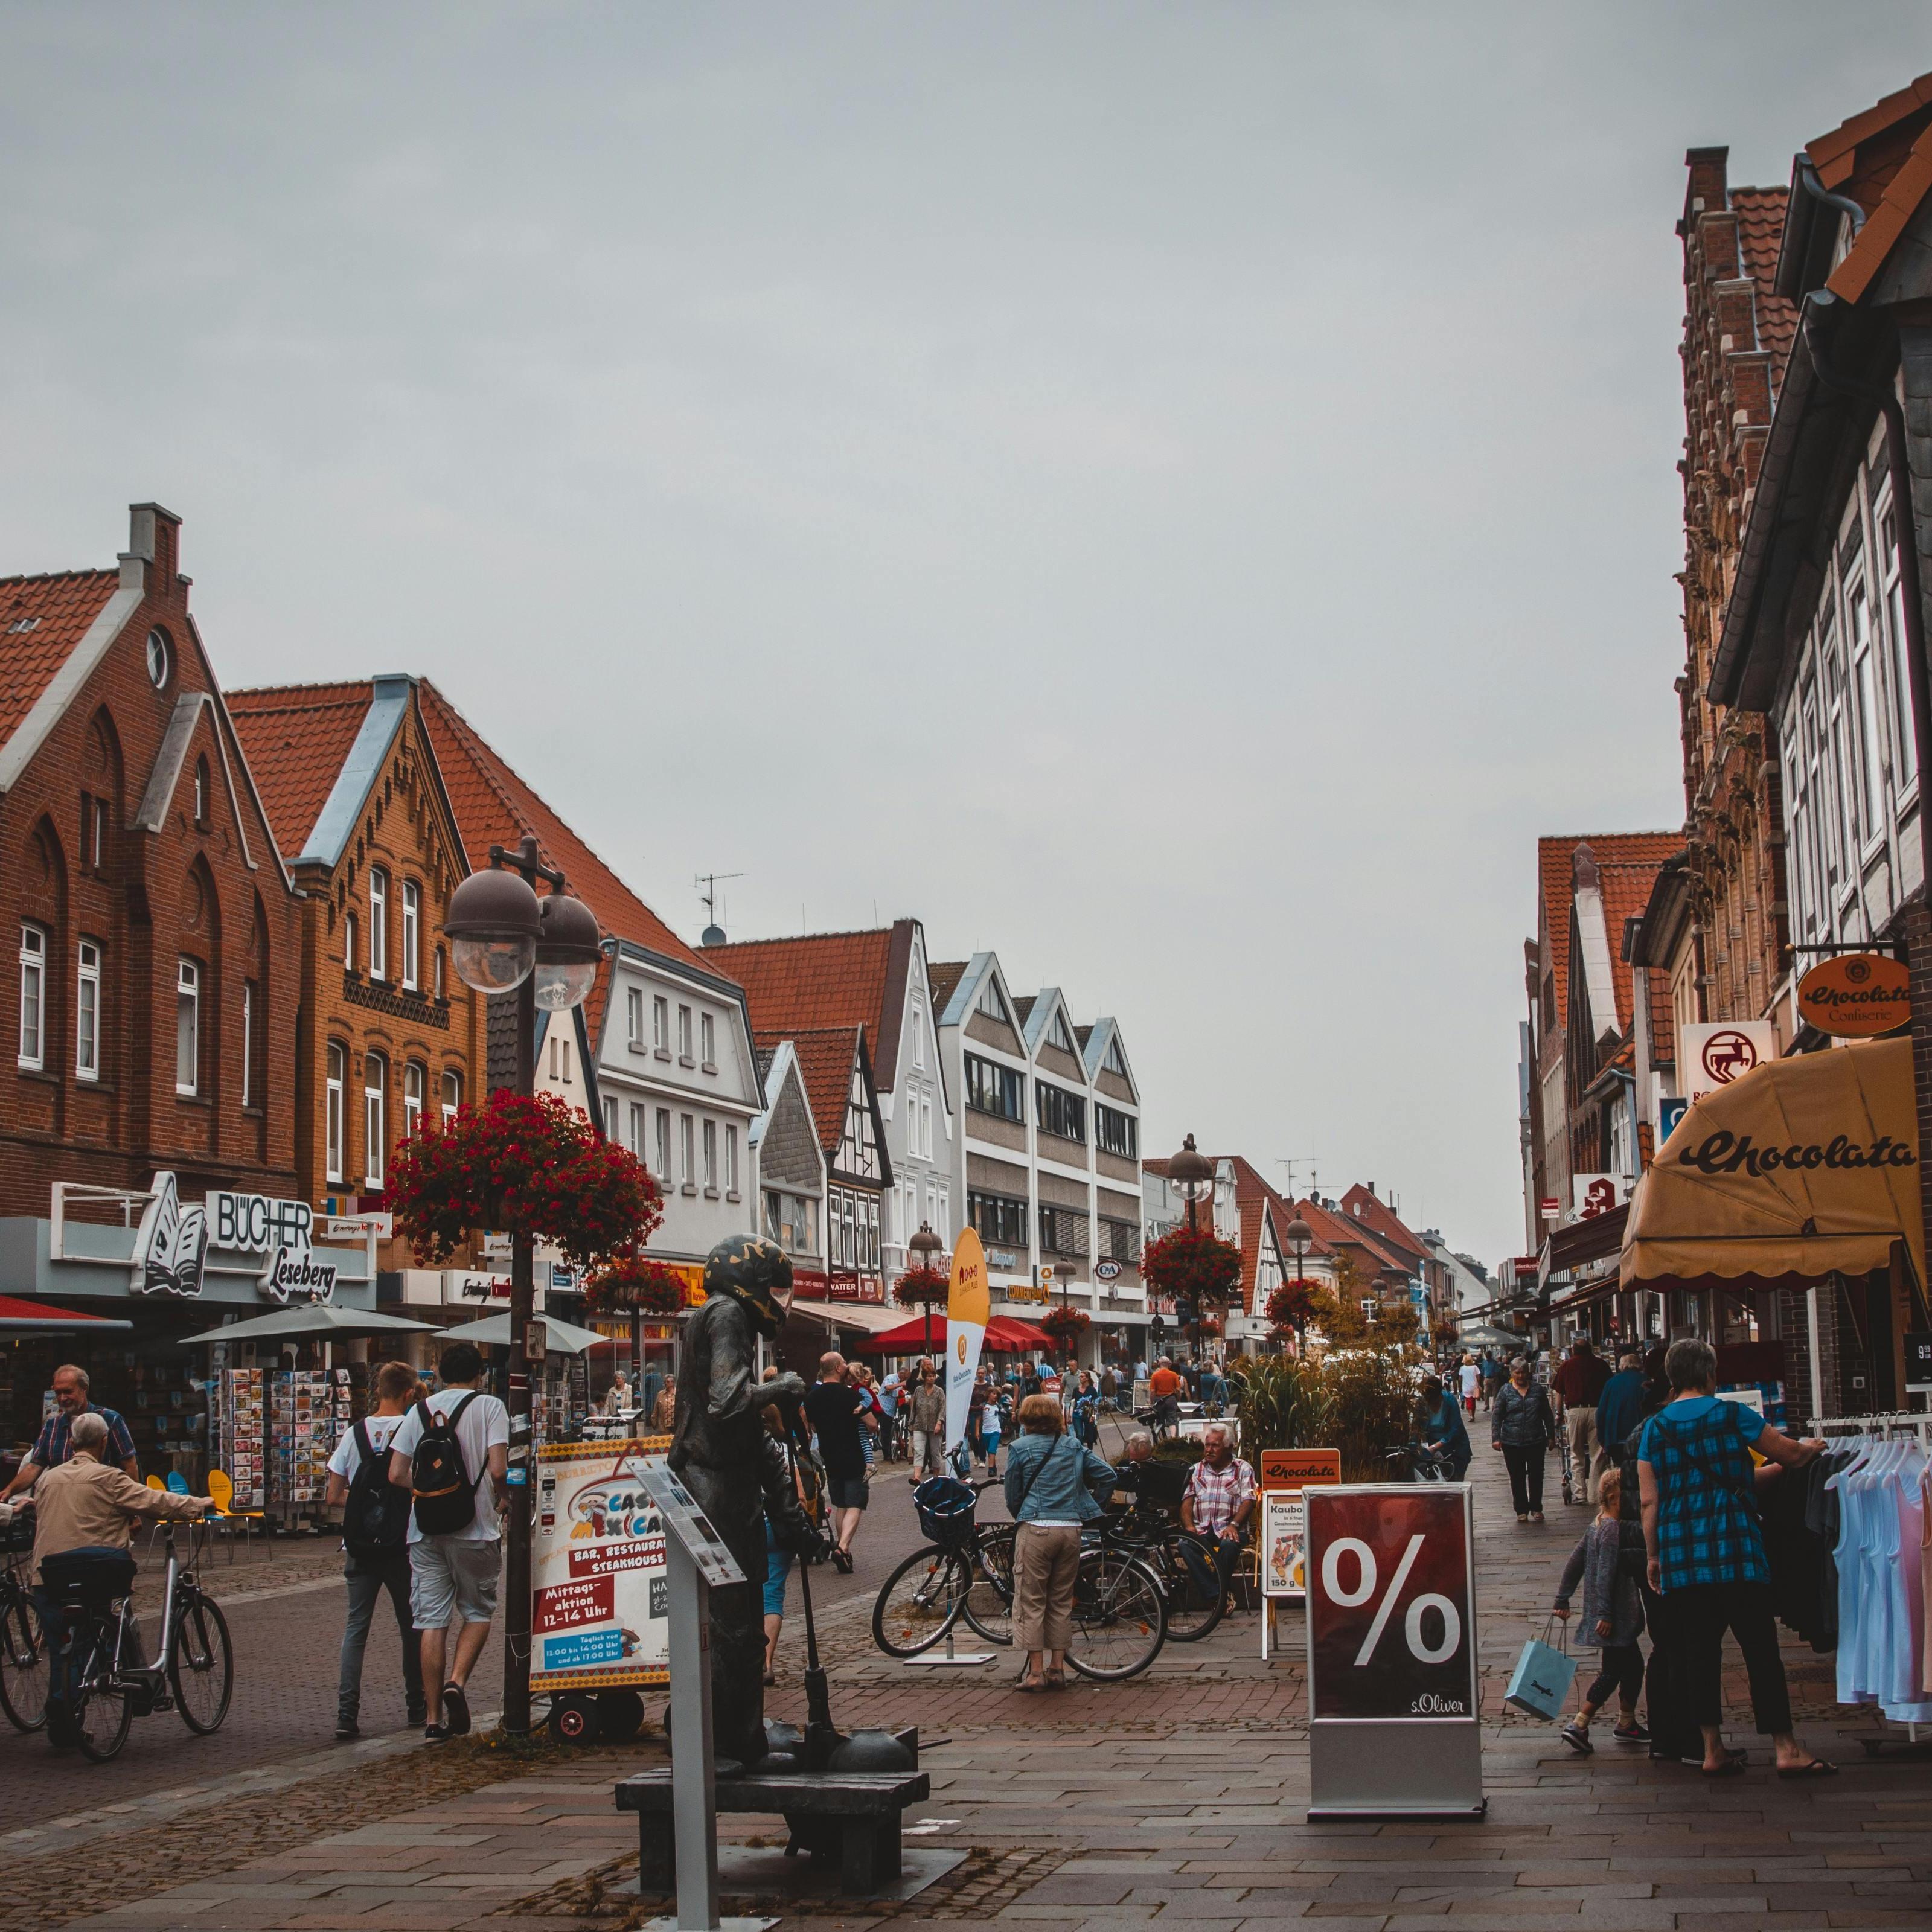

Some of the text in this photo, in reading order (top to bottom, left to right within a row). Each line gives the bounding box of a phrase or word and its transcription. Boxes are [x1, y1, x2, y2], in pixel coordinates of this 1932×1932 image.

[1829, 1008, 1892, 1022] Confiserie
[1678, 1130, 1917, 1177] Chocolata
[219, 1194, 310, 1250] BÜCHER
[270, 1247, 336, 1299] Leseberg
[1099, 1265, 1116, 1275] C&A
[1918, 1345, 1924, 1359] 9
[1266, 1464, 1335, 1479] Chocolata
[574, 1549, 600, 1562] BAR,
[592, 1553, 664, 1573] STEAKHOUSE
[545, 1582, 601, 1600] Mittags-
[555, 1596, 594, 1611] aktion
[543, 1605, 607, 1627] 12-14 Uhr
[1410, 1693, 1464, 1713] s.Oliver
